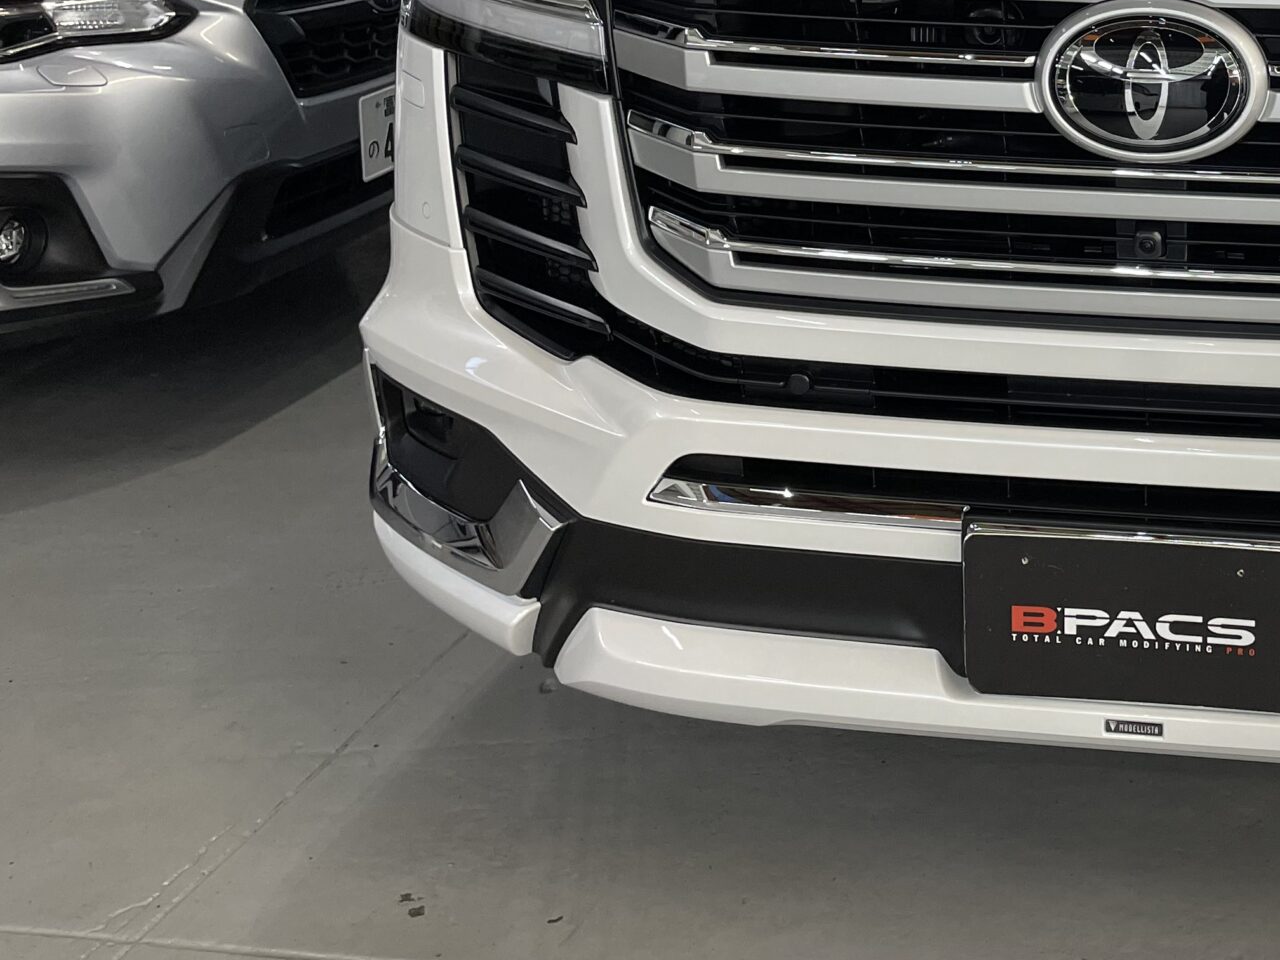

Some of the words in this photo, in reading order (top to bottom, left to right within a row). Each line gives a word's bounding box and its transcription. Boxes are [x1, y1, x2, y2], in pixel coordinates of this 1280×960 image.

[369, 141, 380, 158] の
[1011, 633, 1061, 644] TOTAL
[1075, 636, 1105, 646] CAR
[1119, 639, 1213, 653] MODIFYING
[1225, 646, 1256, 657] PRO
[1118, 723, 1159, 735] MODELLISTA
